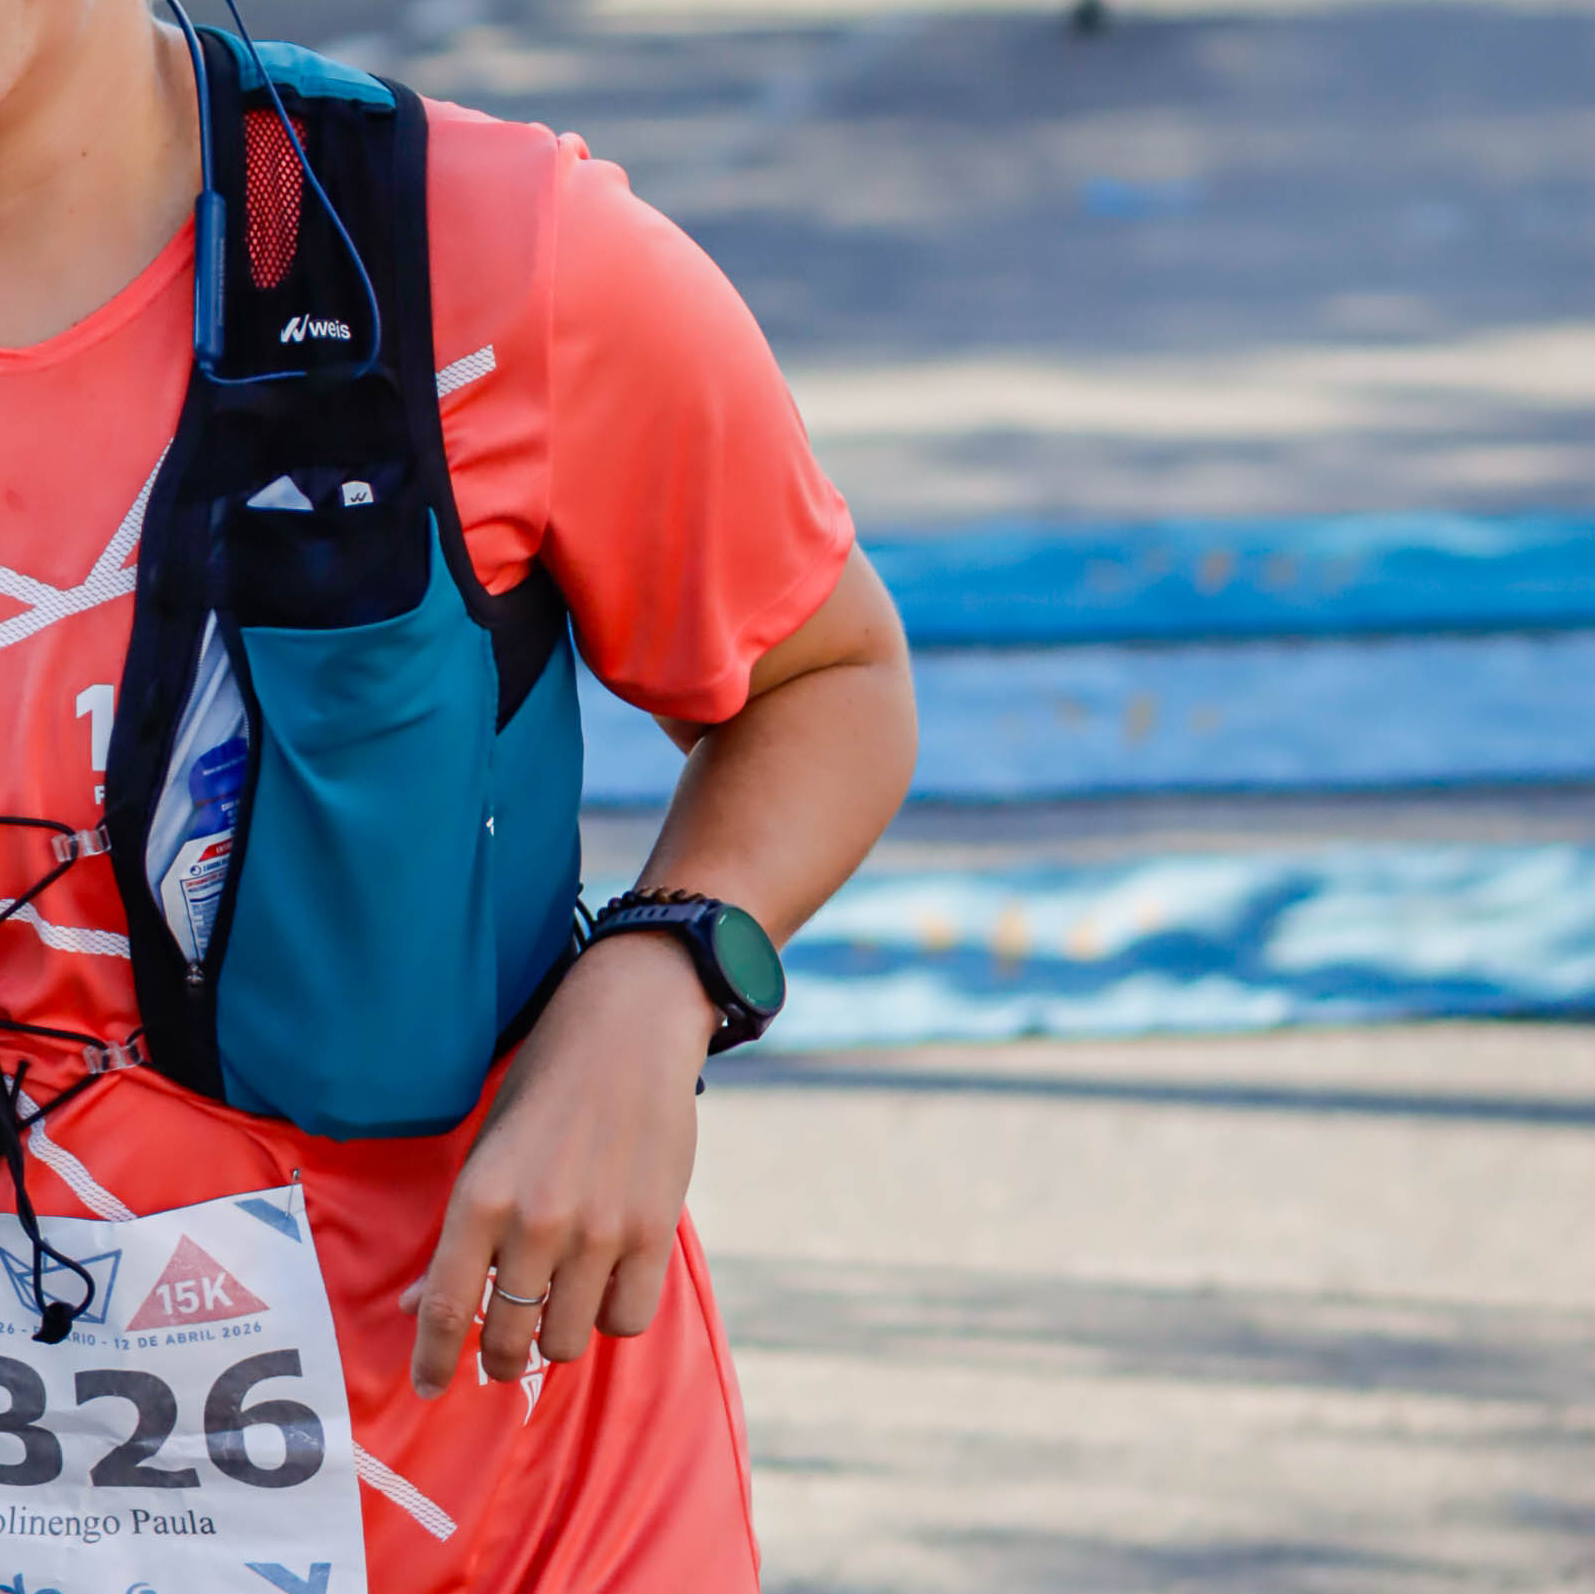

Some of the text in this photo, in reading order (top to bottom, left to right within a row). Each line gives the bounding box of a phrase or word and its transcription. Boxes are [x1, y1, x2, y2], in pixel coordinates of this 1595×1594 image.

[308, 319, 351, 340] weis
[156, 1272, 234, 1316] 15K
[114, 1338, 130, 1350] 12
[138, 1336, 158, 1348] DE
[165, 1330, 215, 1345] ABRIL
[222, 1322, 262, 1339] 2026
[130, 1508, 217, 1535] Paula
